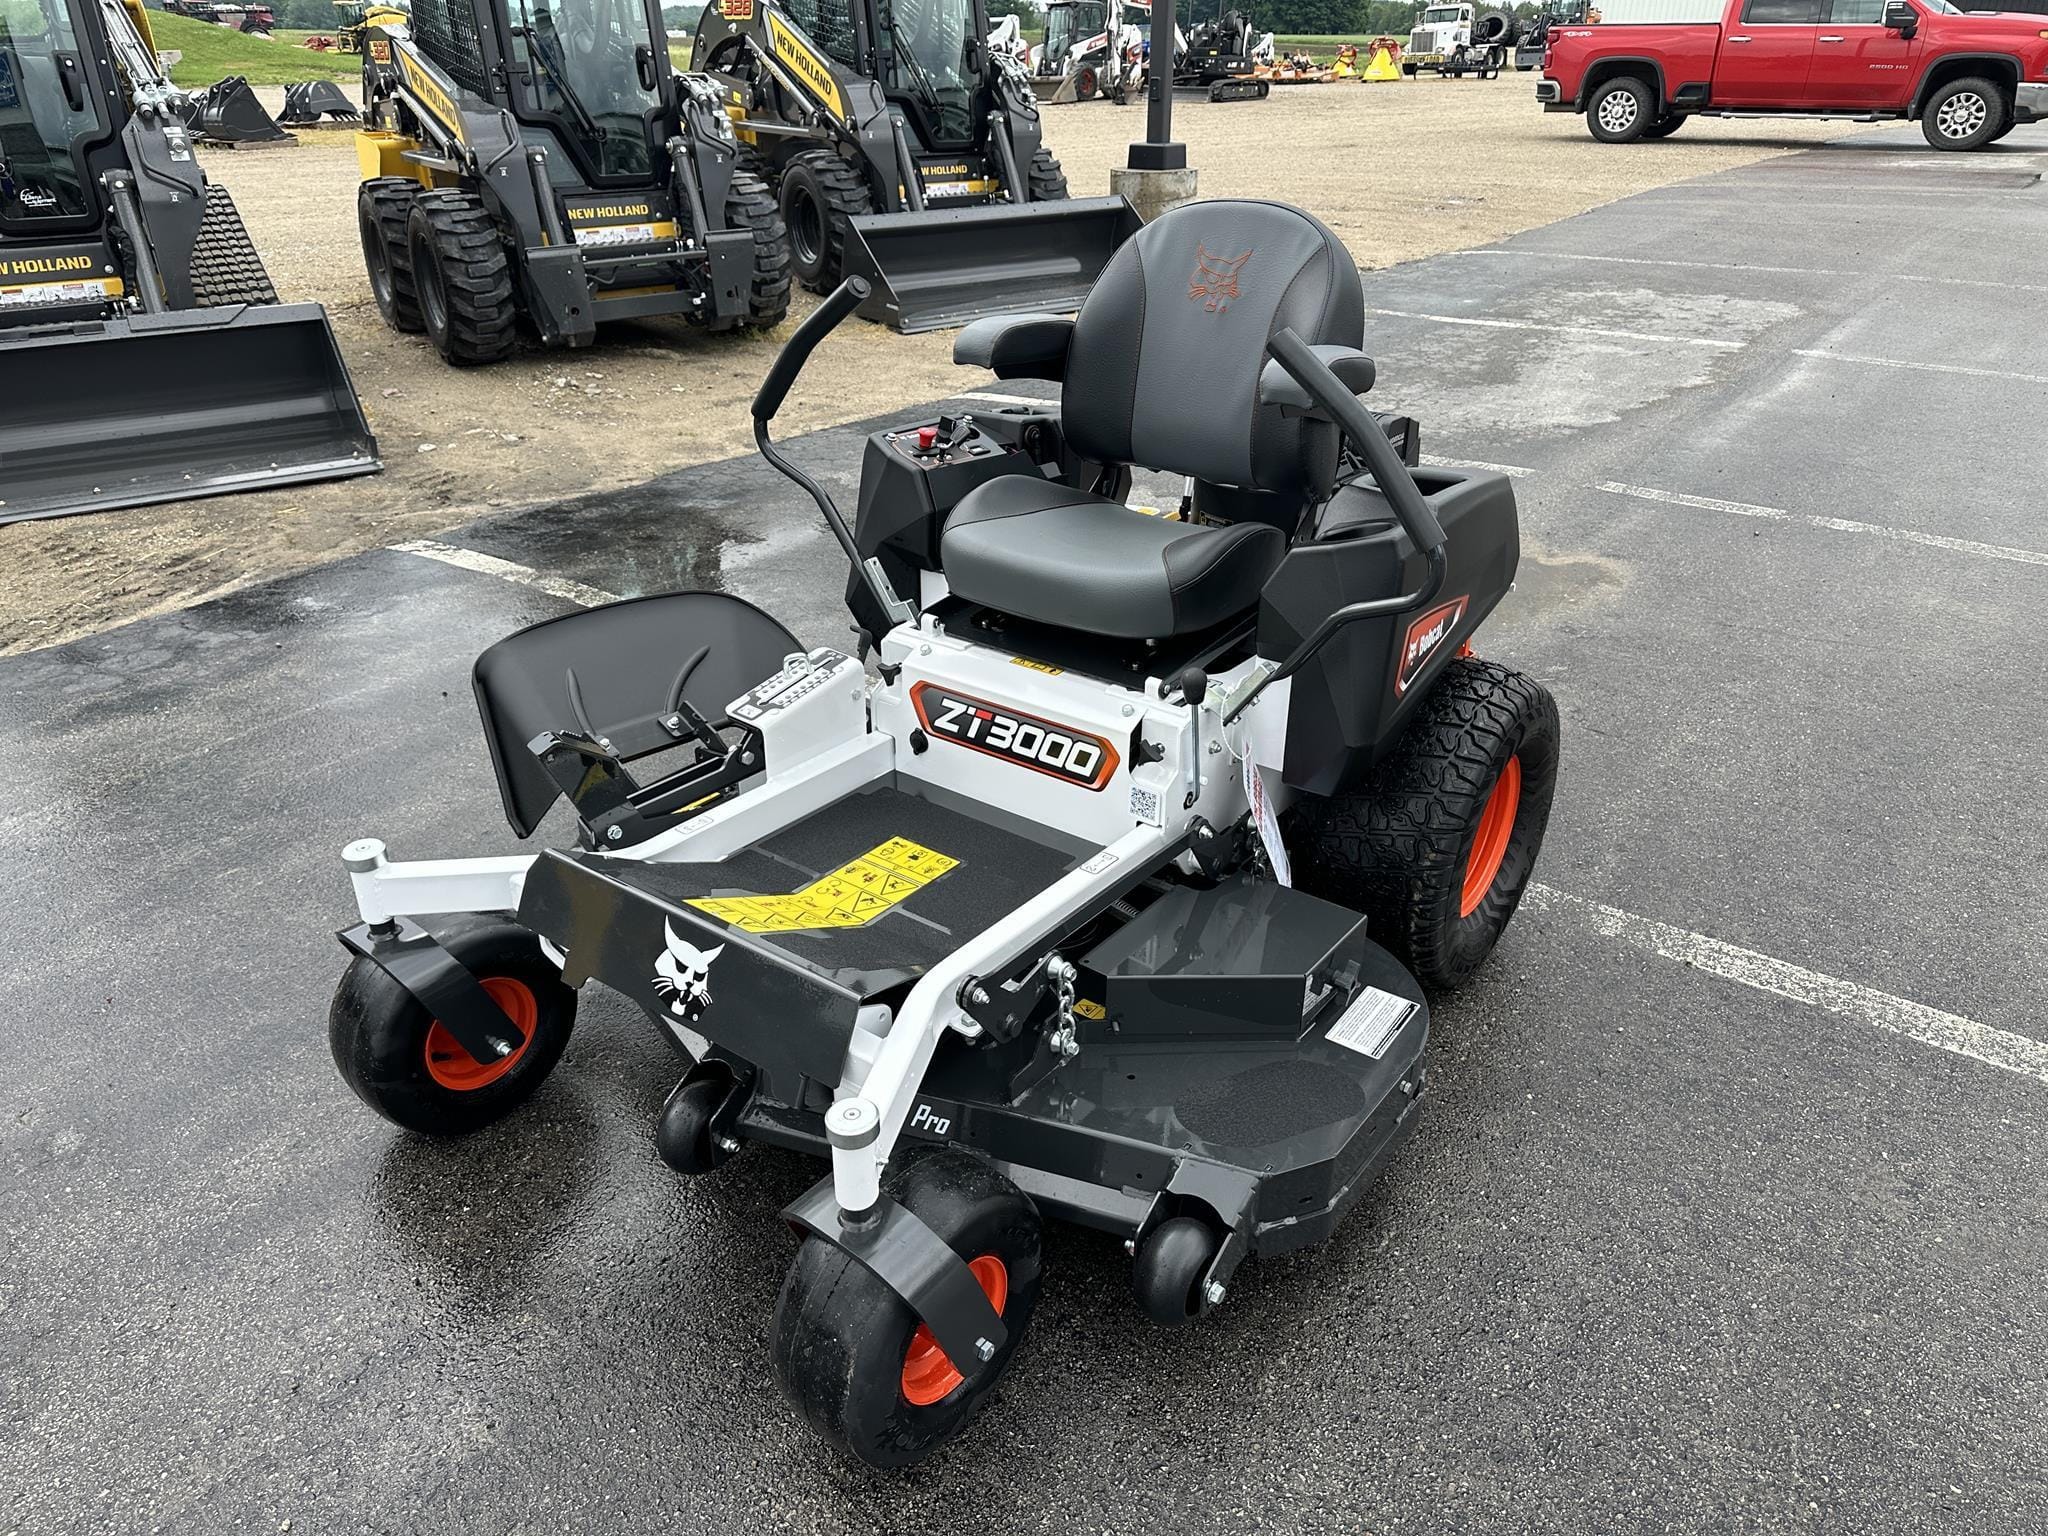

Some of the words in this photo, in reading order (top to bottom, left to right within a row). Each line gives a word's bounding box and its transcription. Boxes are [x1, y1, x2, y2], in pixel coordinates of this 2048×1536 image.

[776, 31, 796, 58] NEW
[795, 53, 832, 95] HOLLAND
[409, 66, 426, 93] NEW
[425, 82, 457, 126] HOLLAND
[930, 165, 968, 175] HOLLAND
[567, 208, 595, 220] NEW
[597, 204, 649, 218] HOLLAND
[11, 256, 92, 274] HOLLAND
[1418, 618, 1444, 657] Bobcat
[933, 697, 1101, 777] ZT3000
[910, 1103, 951, 1135] Pro
